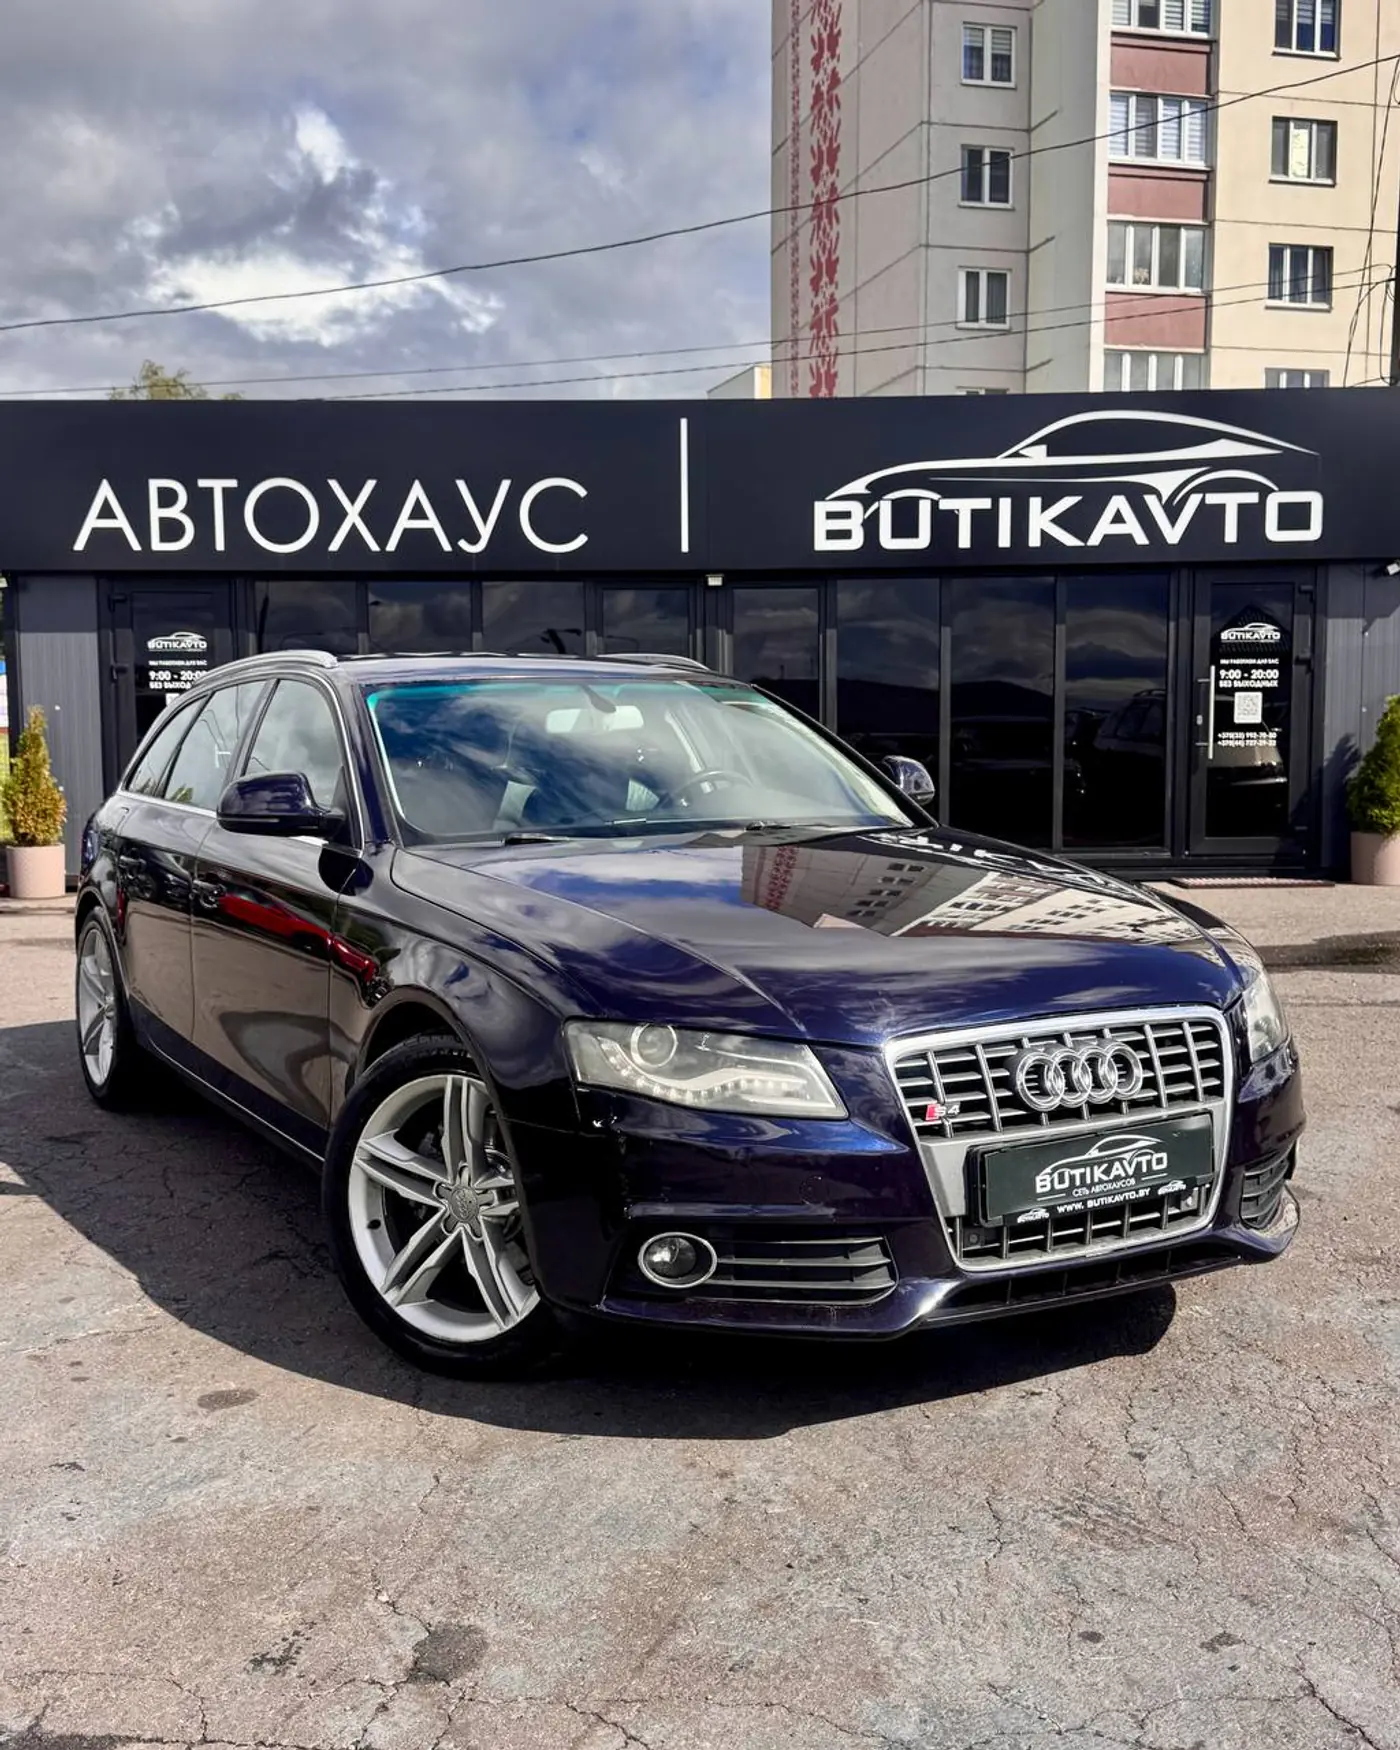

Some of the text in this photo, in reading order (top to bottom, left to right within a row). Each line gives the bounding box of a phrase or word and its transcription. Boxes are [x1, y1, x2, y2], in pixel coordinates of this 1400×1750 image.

[73, 477, 589, 554] АВТОХАУС
[813, 490, 1325, 551] BUTIKAVTO
[1221, 631, 1281, 640] BUTIKAVTO
[149, 670, 171, 681] 9:00
[1219, 669, 1242, 680] 9:00
[1250, 669, 1280, 680] 20:00
[1035, 1151, 1168, 1194] BUTIKAVTO
[1072, 1187, 1089, 1197] СЕТЬ
[1087, 1188, 1151, 1208] BUTIKAVTO.BY
